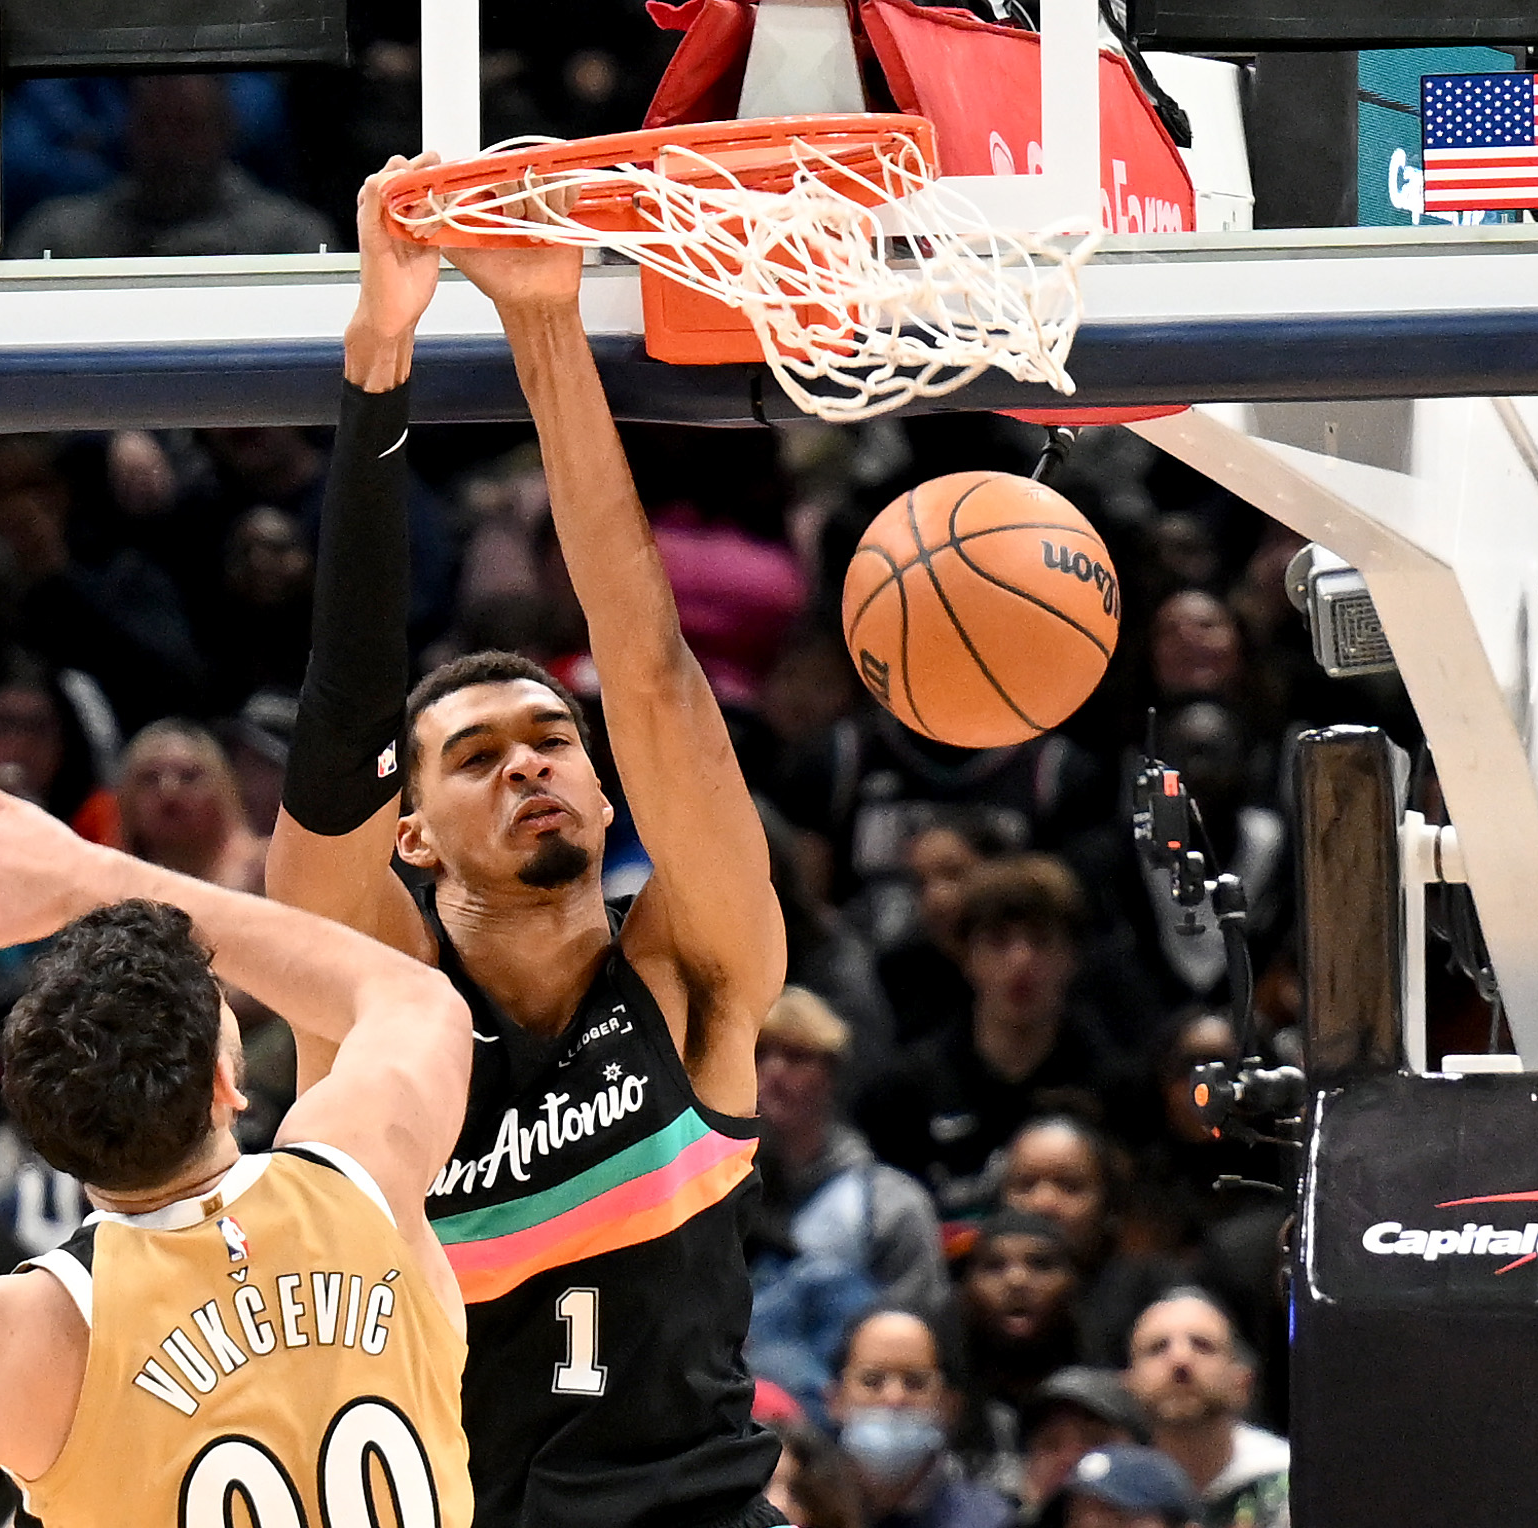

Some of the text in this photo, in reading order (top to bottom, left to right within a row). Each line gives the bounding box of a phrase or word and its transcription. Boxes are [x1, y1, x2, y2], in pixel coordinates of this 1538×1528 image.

[477, 1074, 649, 1189] Antonio
[133, 1266, 401, 1418] VUKČEVIĆ
[551, 1287, 609, 1397] 1
